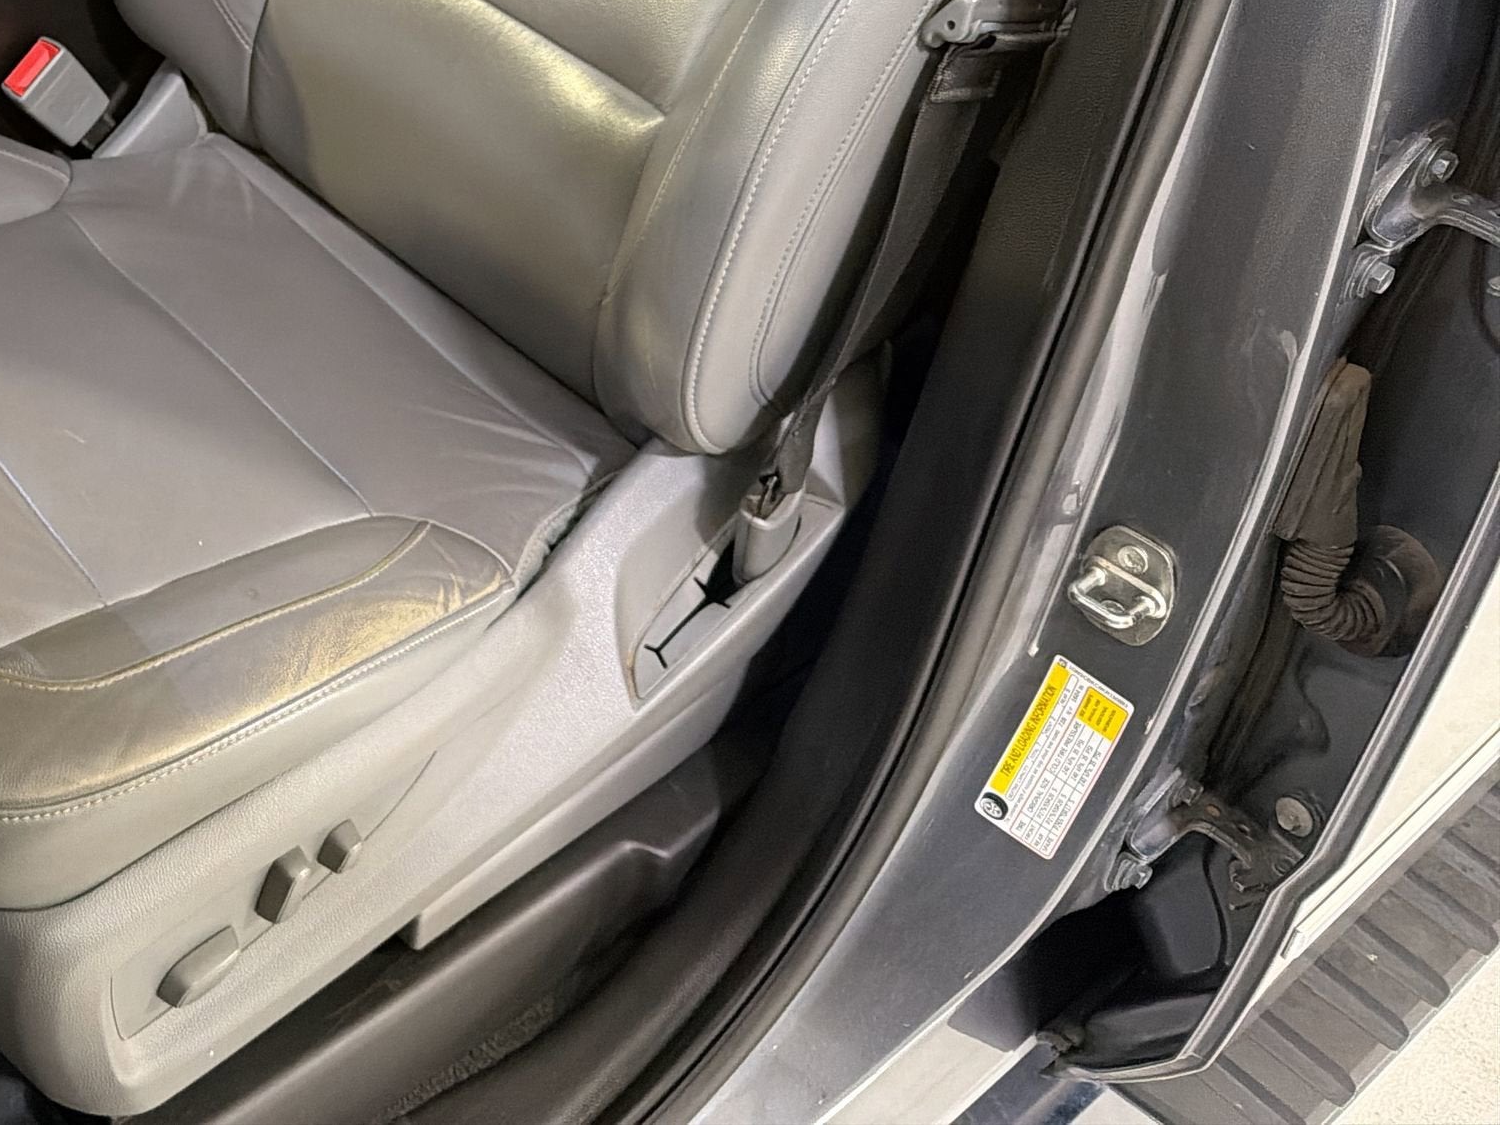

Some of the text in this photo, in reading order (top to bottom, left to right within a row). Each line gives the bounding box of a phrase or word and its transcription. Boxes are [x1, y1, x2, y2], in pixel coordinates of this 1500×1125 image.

[999, 682, 1057, 778] TIRE AND LOADING INFORMATION
[1048, 719, 1082, 774] COLD TIRE PRESSURE
